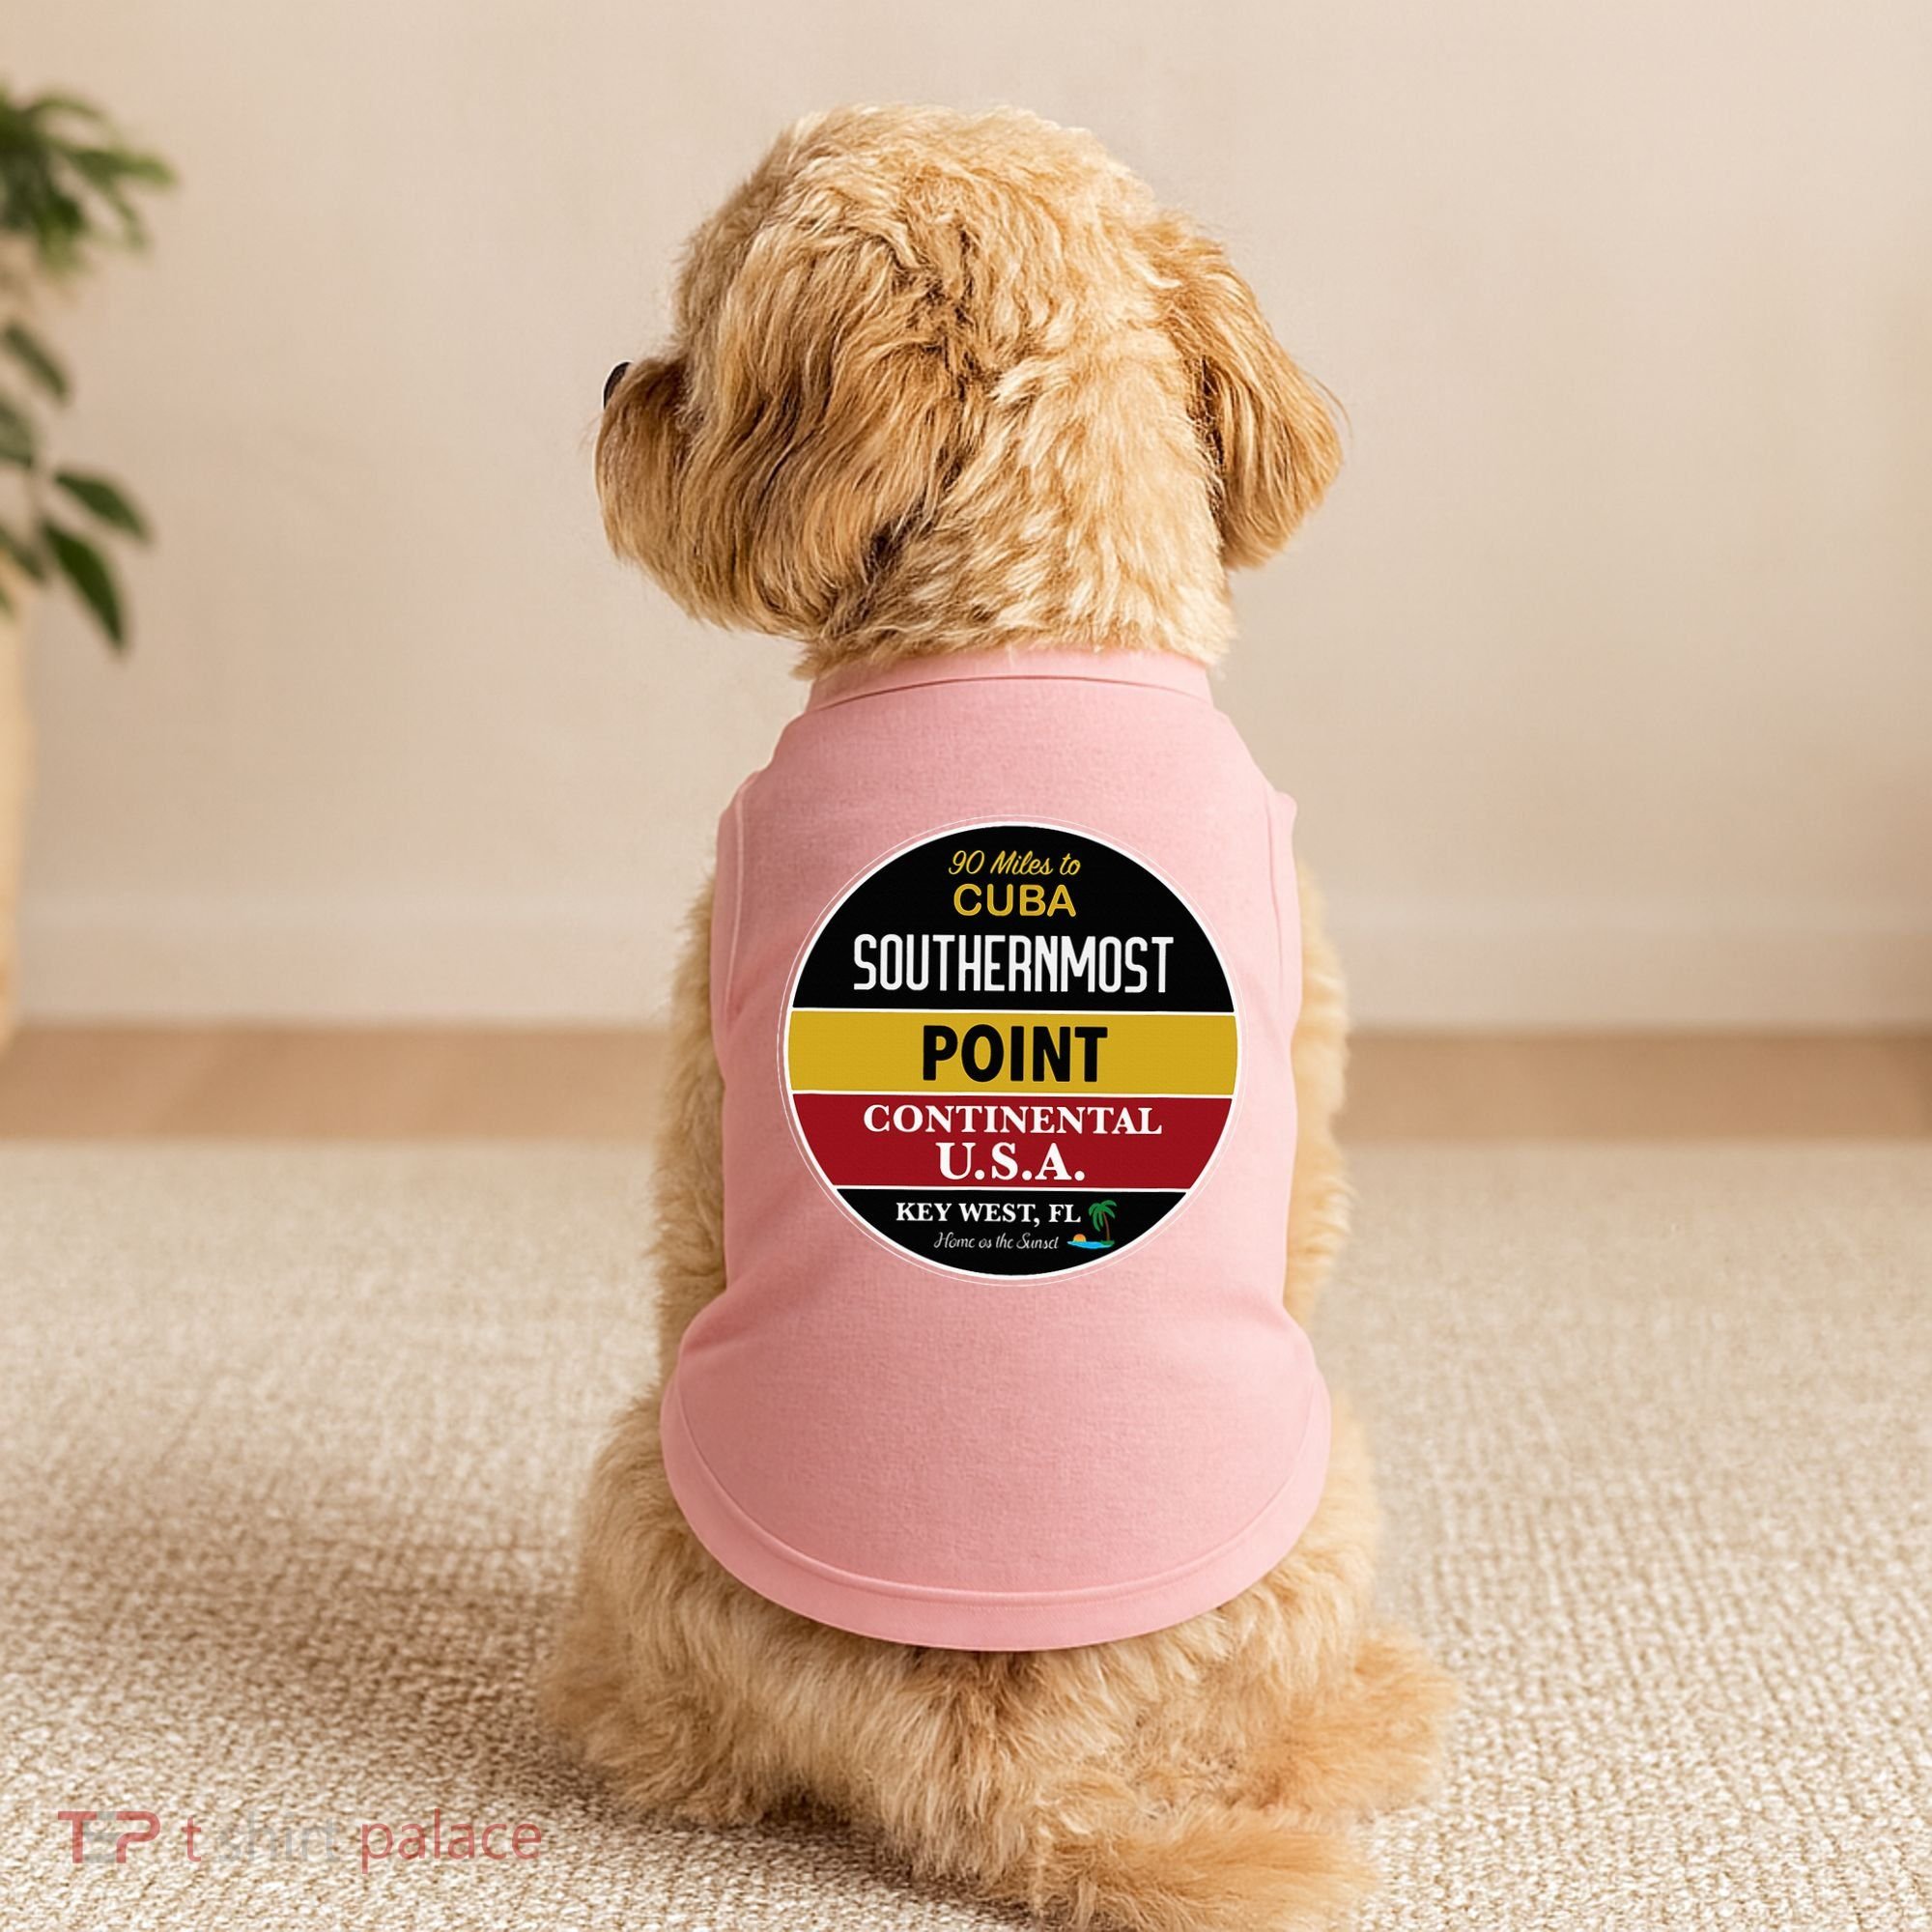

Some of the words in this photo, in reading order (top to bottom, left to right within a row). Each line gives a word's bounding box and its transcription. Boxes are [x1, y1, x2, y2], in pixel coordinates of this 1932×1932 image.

[948, 850, 983, 875] 90
[989, 850, 1054, 875] Miles
[1060, 851, 1081, 875] to
[953, 883, 1077, 918] CUBA
[854, 934, 1174, 993] SOUTHERNMOST
[923, 1024, 1108, 1082] POINT
[863, 1104, 1163, 1135] CONTINENTAL
[935, 1142, 1086, 1181] U.S.A.
[895, 1202, 952, 1222] KEY
[958, 1203, 1040, 1227] WEST,
[1048, 1204, 1082, 1223] FL
